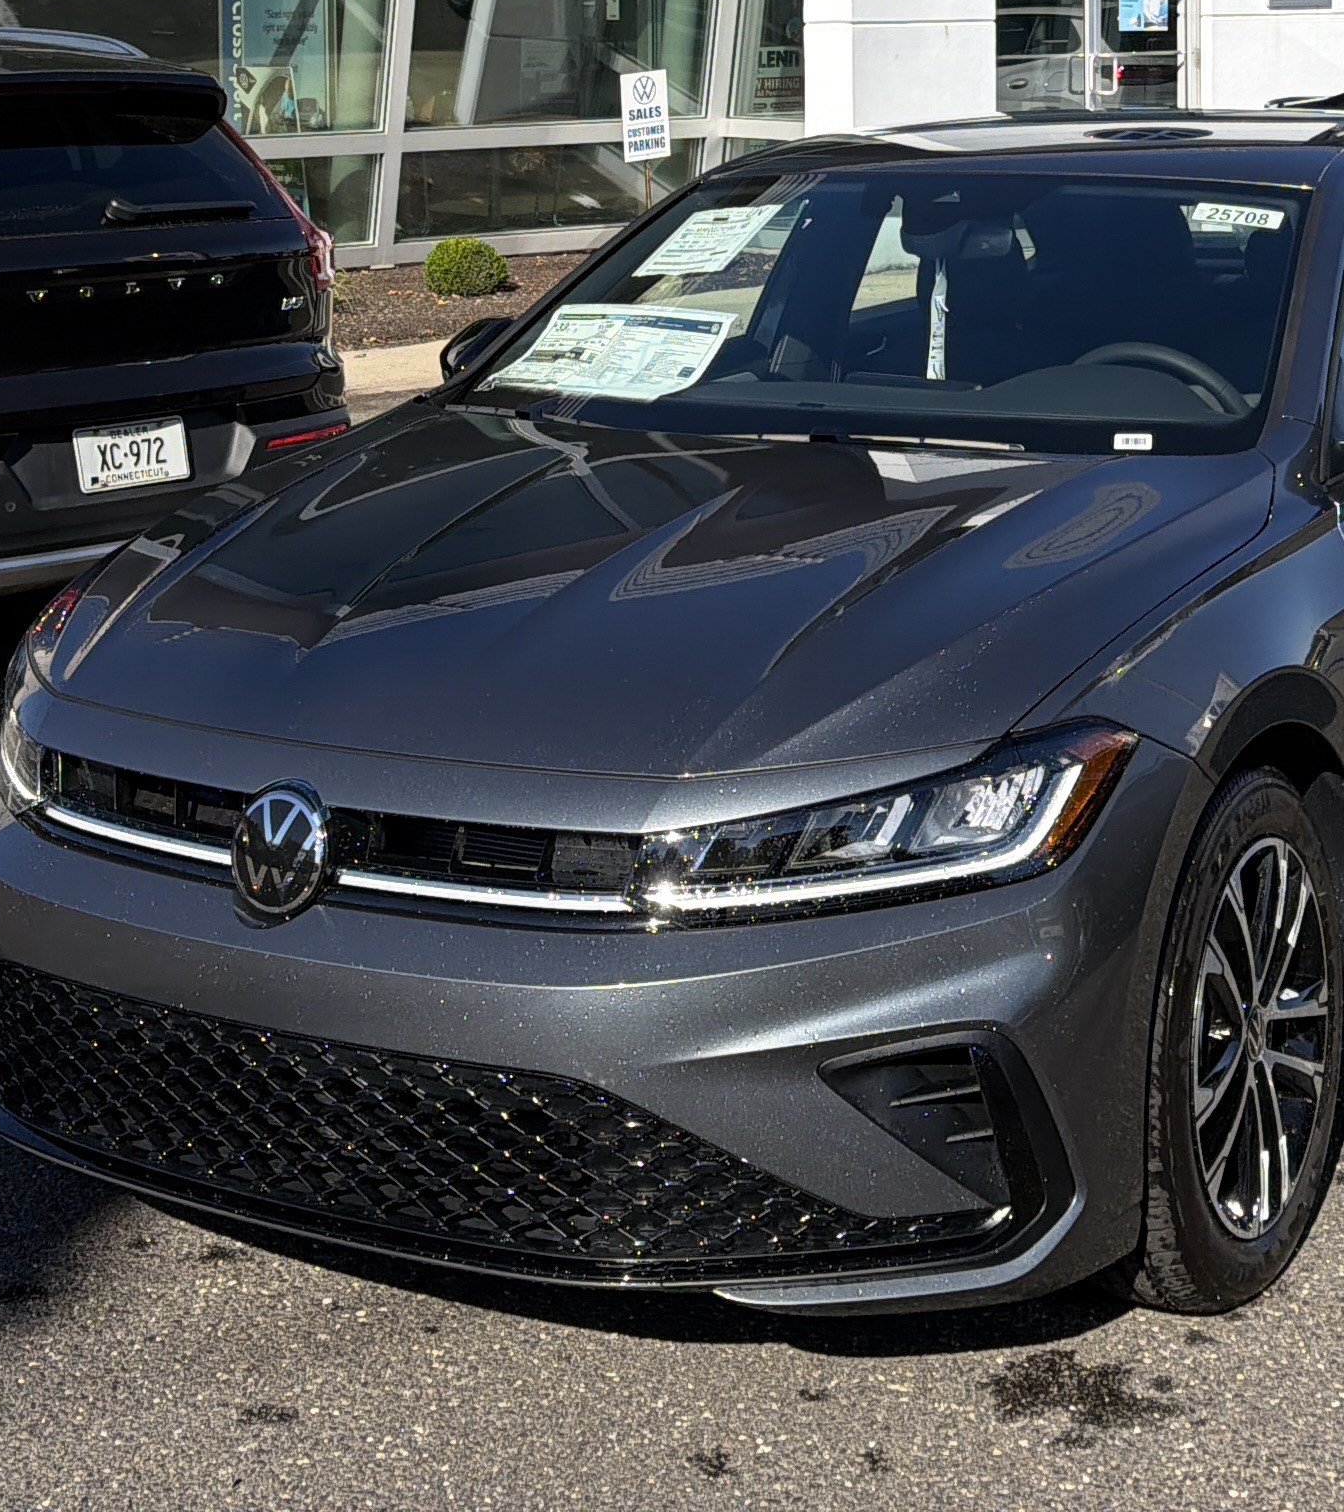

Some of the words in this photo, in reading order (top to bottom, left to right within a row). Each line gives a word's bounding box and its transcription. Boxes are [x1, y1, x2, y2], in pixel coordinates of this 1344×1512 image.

[628, 105, 662, 122] SALES
[627, 124, 665, 139] CUSTOMER
[628, 136, 666, 153] PARKING
[1206, 208, 1269, 225] 25708
[110, 426, 149, 439] DEALER
[105, 467, 164, 484] CONNECTICUT
